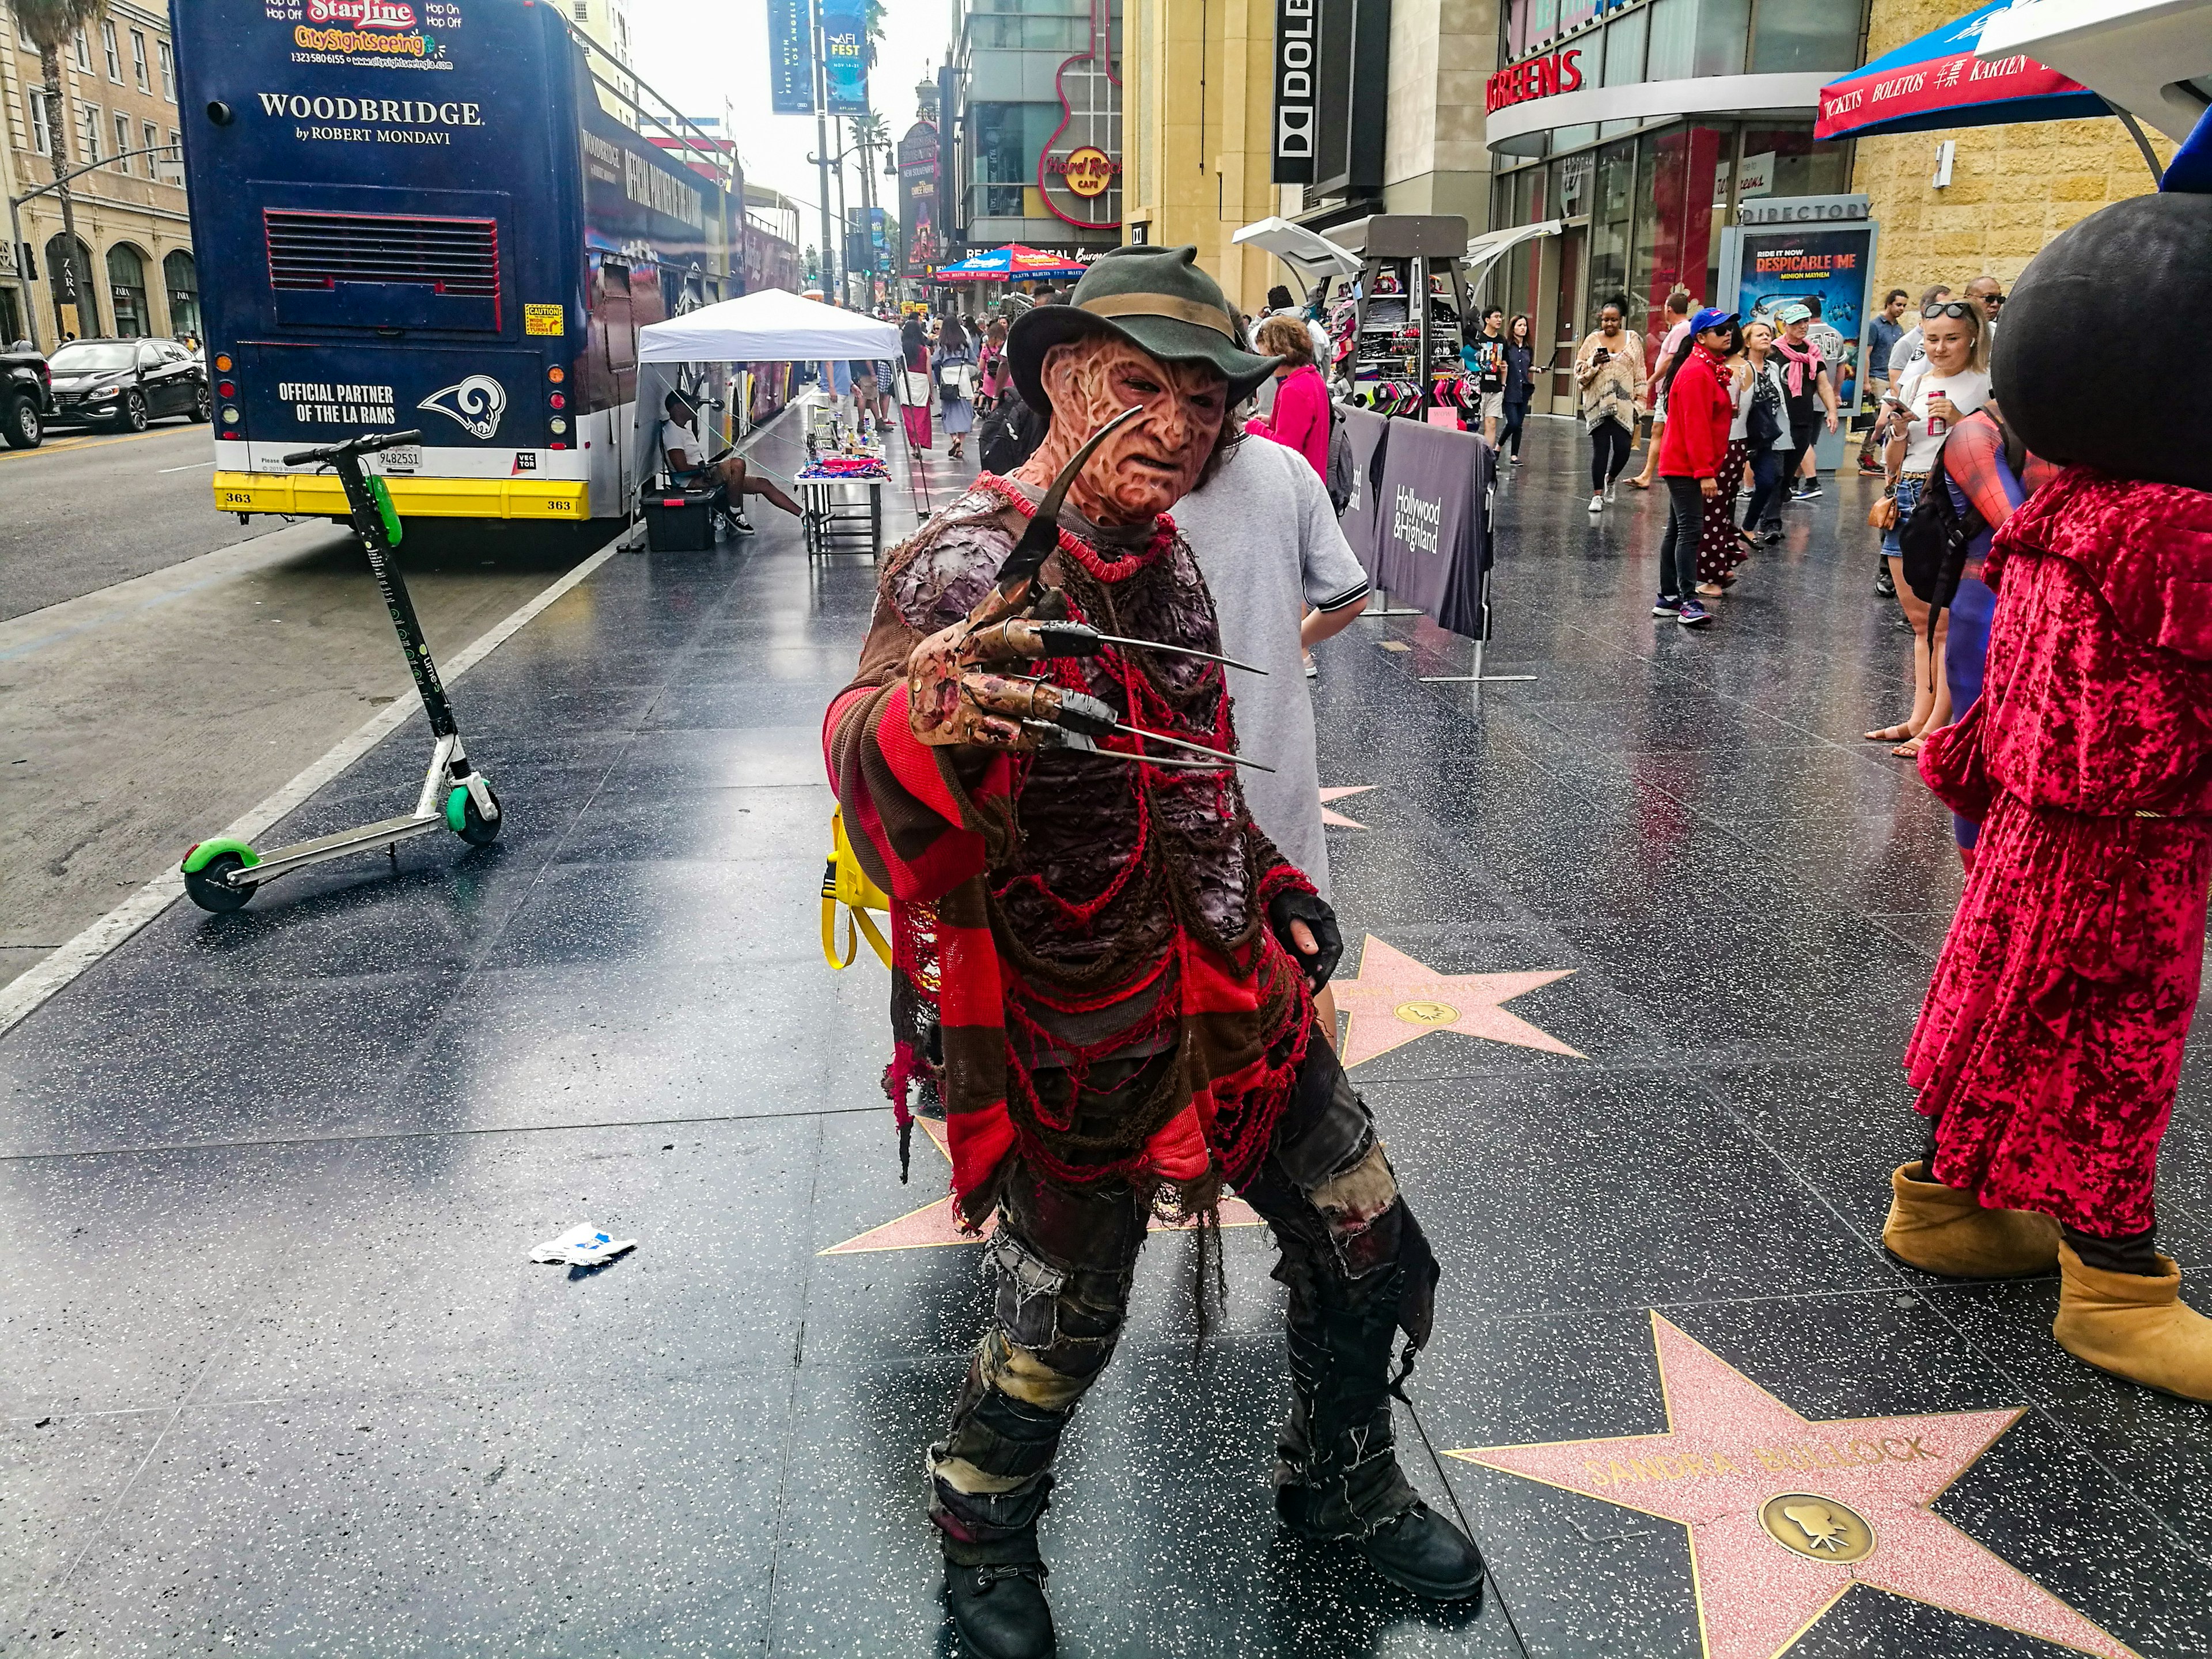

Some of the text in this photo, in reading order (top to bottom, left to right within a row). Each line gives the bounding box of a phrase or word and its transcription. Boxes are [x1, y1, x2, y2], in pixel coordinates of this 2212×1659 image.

[266, 8, 302, 20] Hop Off
[426, 3, 460, 14] Hop On
[426, 17, 461, 28] Hop Off
[294, 25, 425, 57] CitySightseeing
[838, 33, 855, 44] AFI
[831, 44, 860, 56] FEST
[1486, 50, 1582, 117] GREENS
[1824, 71, 1927, 120] ICKETS BOLETOS
[296, 127, 451, 145] by ROBERT MONDAVI
[582, 128, 620, 169] WOODBRIDGE
[1046, 156, 1088, 175] Hard
[1078, 180, 1099, 188] CAFE
[1741, 202, 1874, 224] DIRECTORY
[1756, 254, 1857, 272] DESPICABLE ME
[62, 258, 76, 297] ZARA
[115, 287, 130, 297] ZARA
[176, 291, 190, 300] ZARA
[279, 382, 394, 403] OFFICIAL PARTNER
[296, 404, 396, 425] OF THE LA RAMS
[380, 453, 419, 464] 94825S1
[226, 493, 251, 503] 363
[547, 501, 570, 510] 363
[1395, 484, 1441, 526] Hollywood
[1393, 512, 1438, 554] &Highland
[1584, 1435, 1944, 1487] SANDRA BULLOCK
